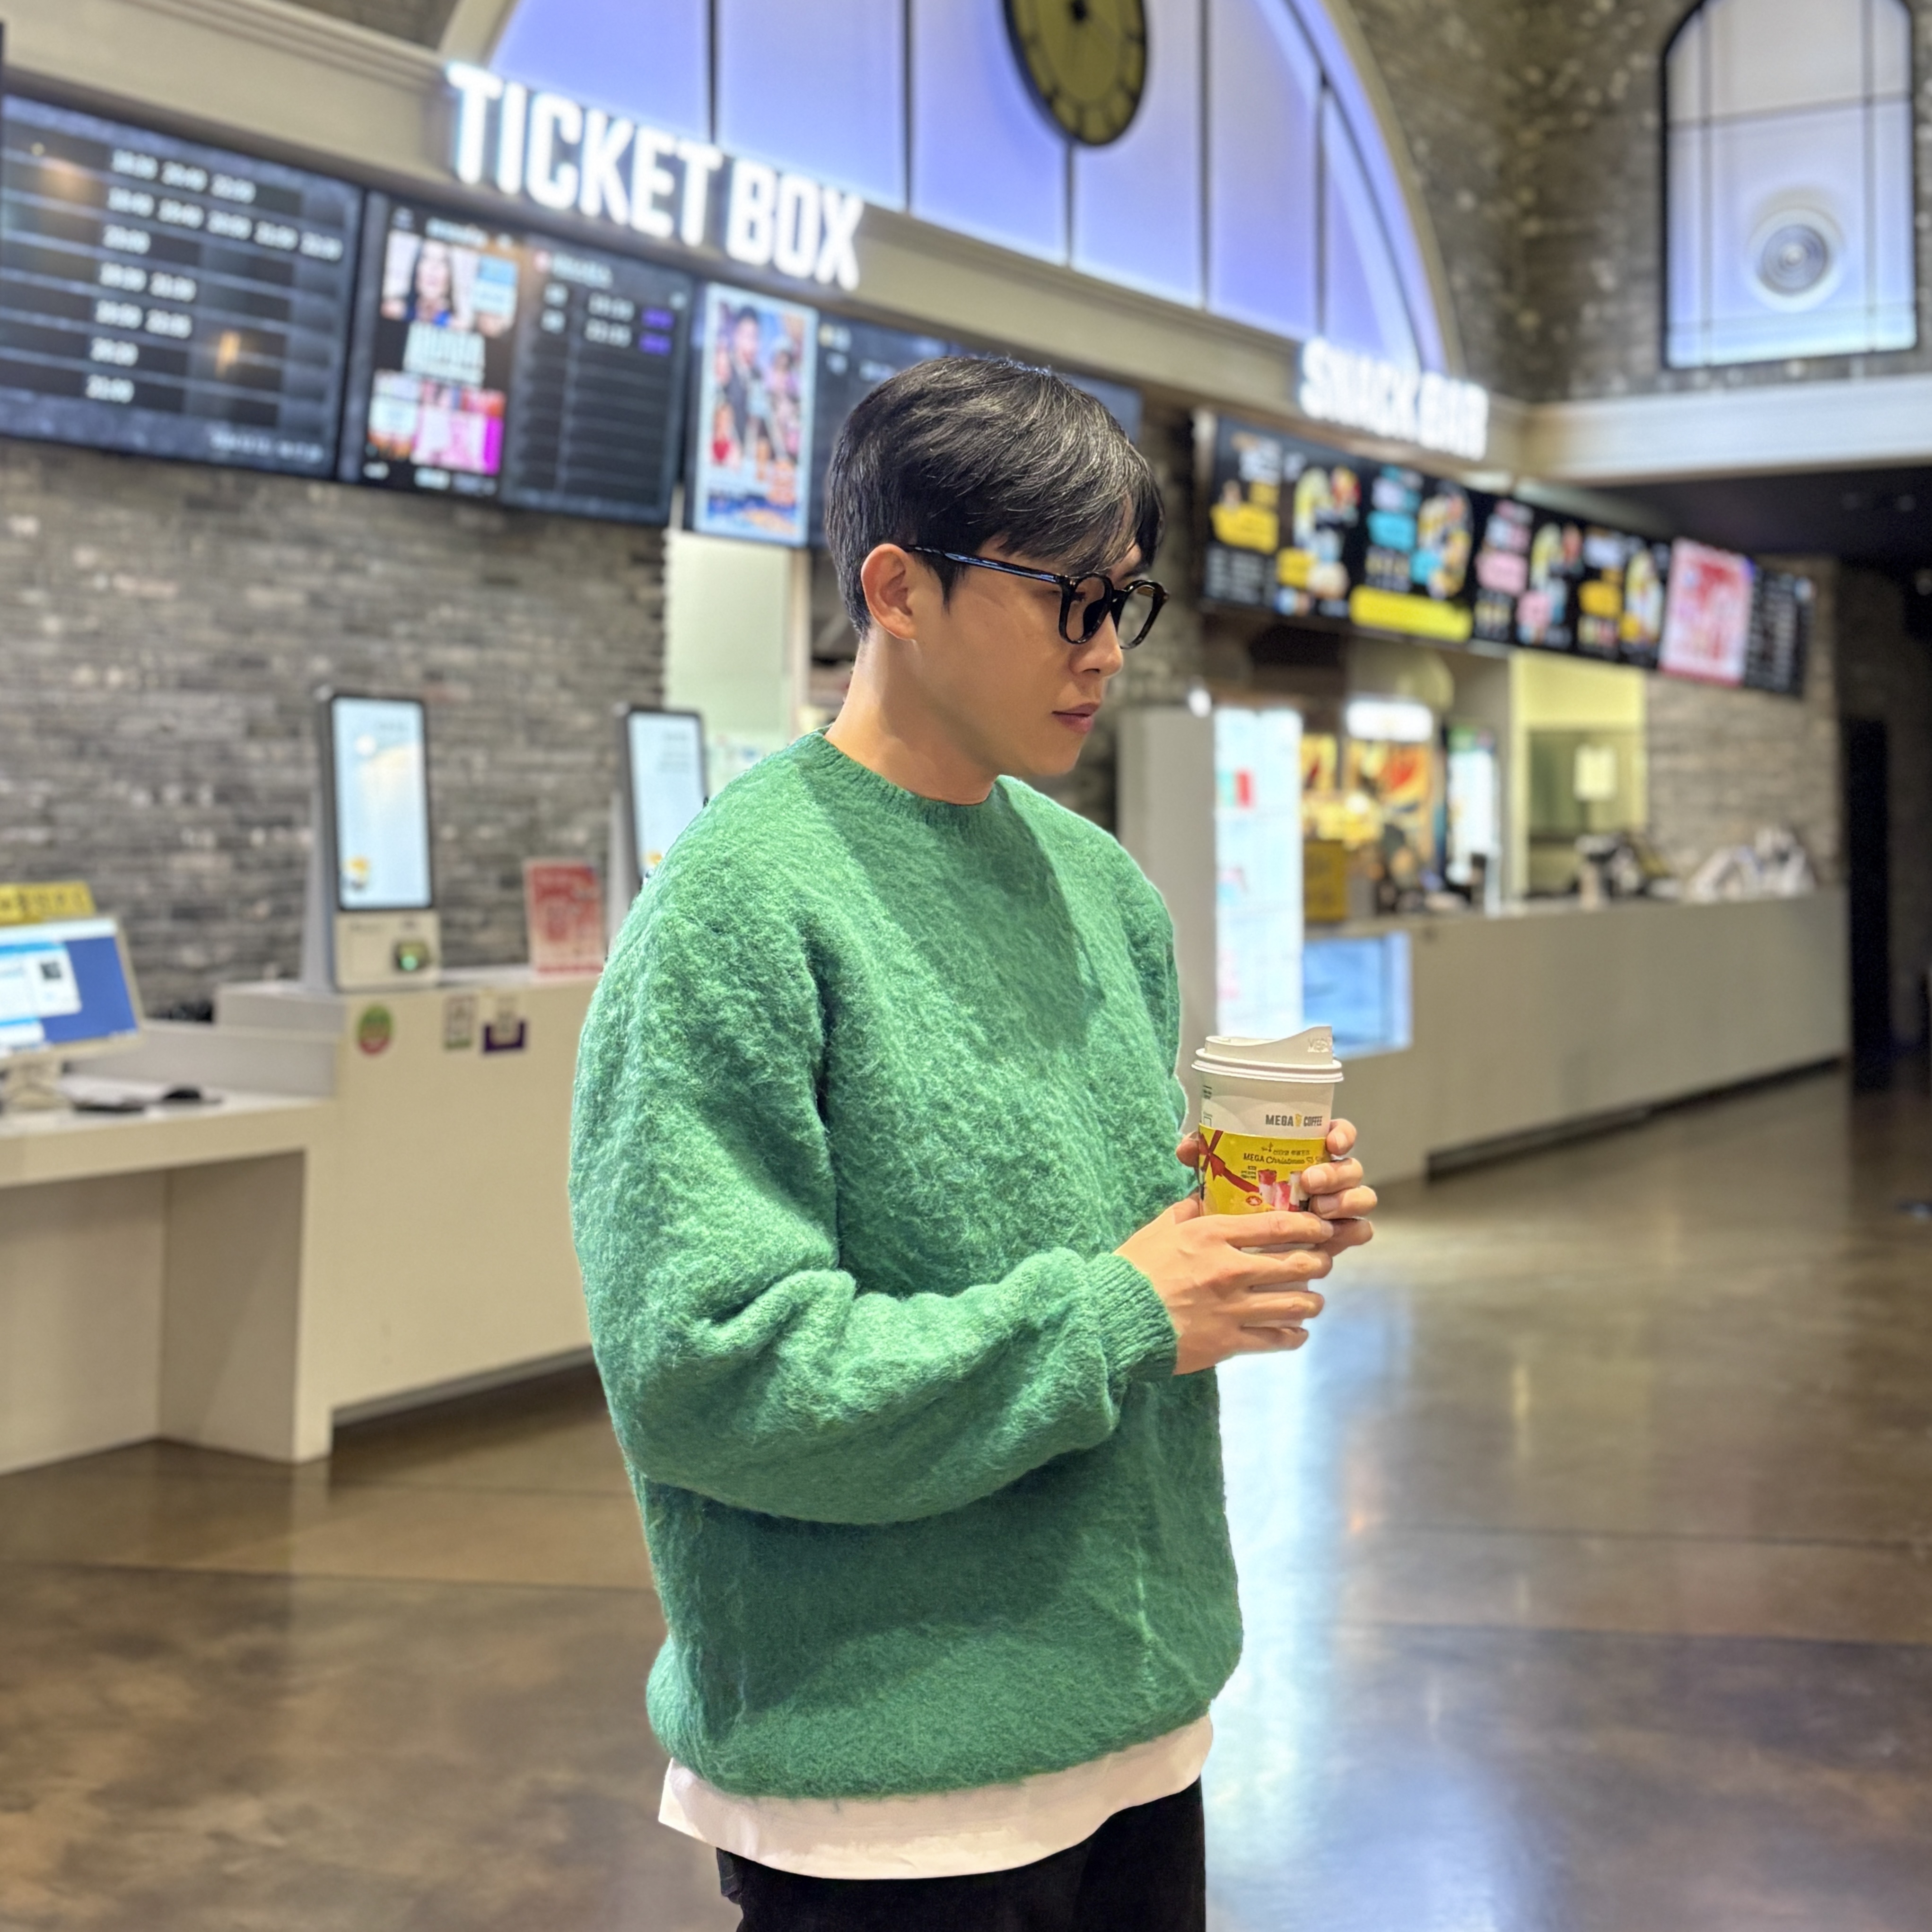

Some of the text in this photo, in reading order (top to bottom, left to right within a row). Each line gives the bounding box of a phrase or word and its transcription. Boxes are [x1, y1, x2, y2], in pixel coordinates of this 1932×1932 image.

[446, 62, 723, 248] TICKET
[725, 158, 865, 291] BOX
[1266, 1114, 1322, 1127] MEGA COFFEE
[1243, 1153, 1265, 1162] MEGA
[1266, 1156, 1305, 1164] Christmas
